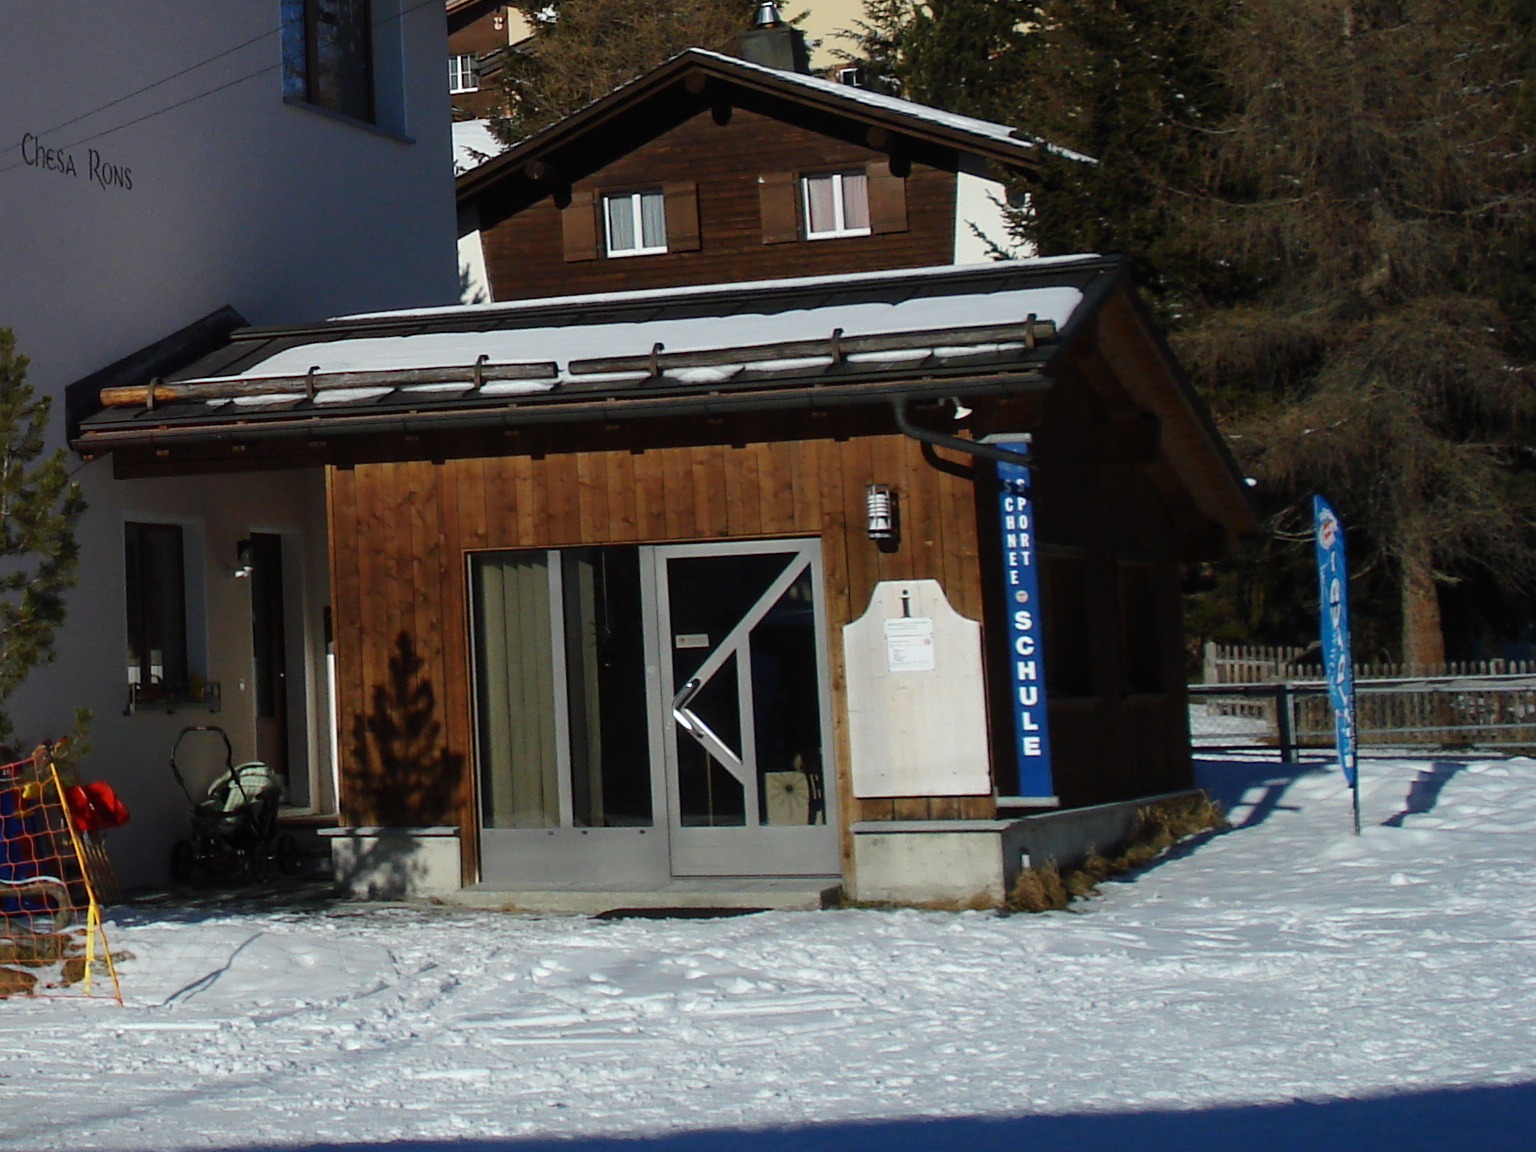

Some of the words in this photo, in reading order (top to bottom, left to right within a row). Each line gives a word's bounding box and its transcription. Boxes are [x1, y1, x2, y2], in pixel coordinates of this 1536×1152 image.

[1004, 479, 1020, 585] SCHNEE
[1015, 478, 1030, 566] SPORT
[1014, 611, 1041, 756] SCHULE
